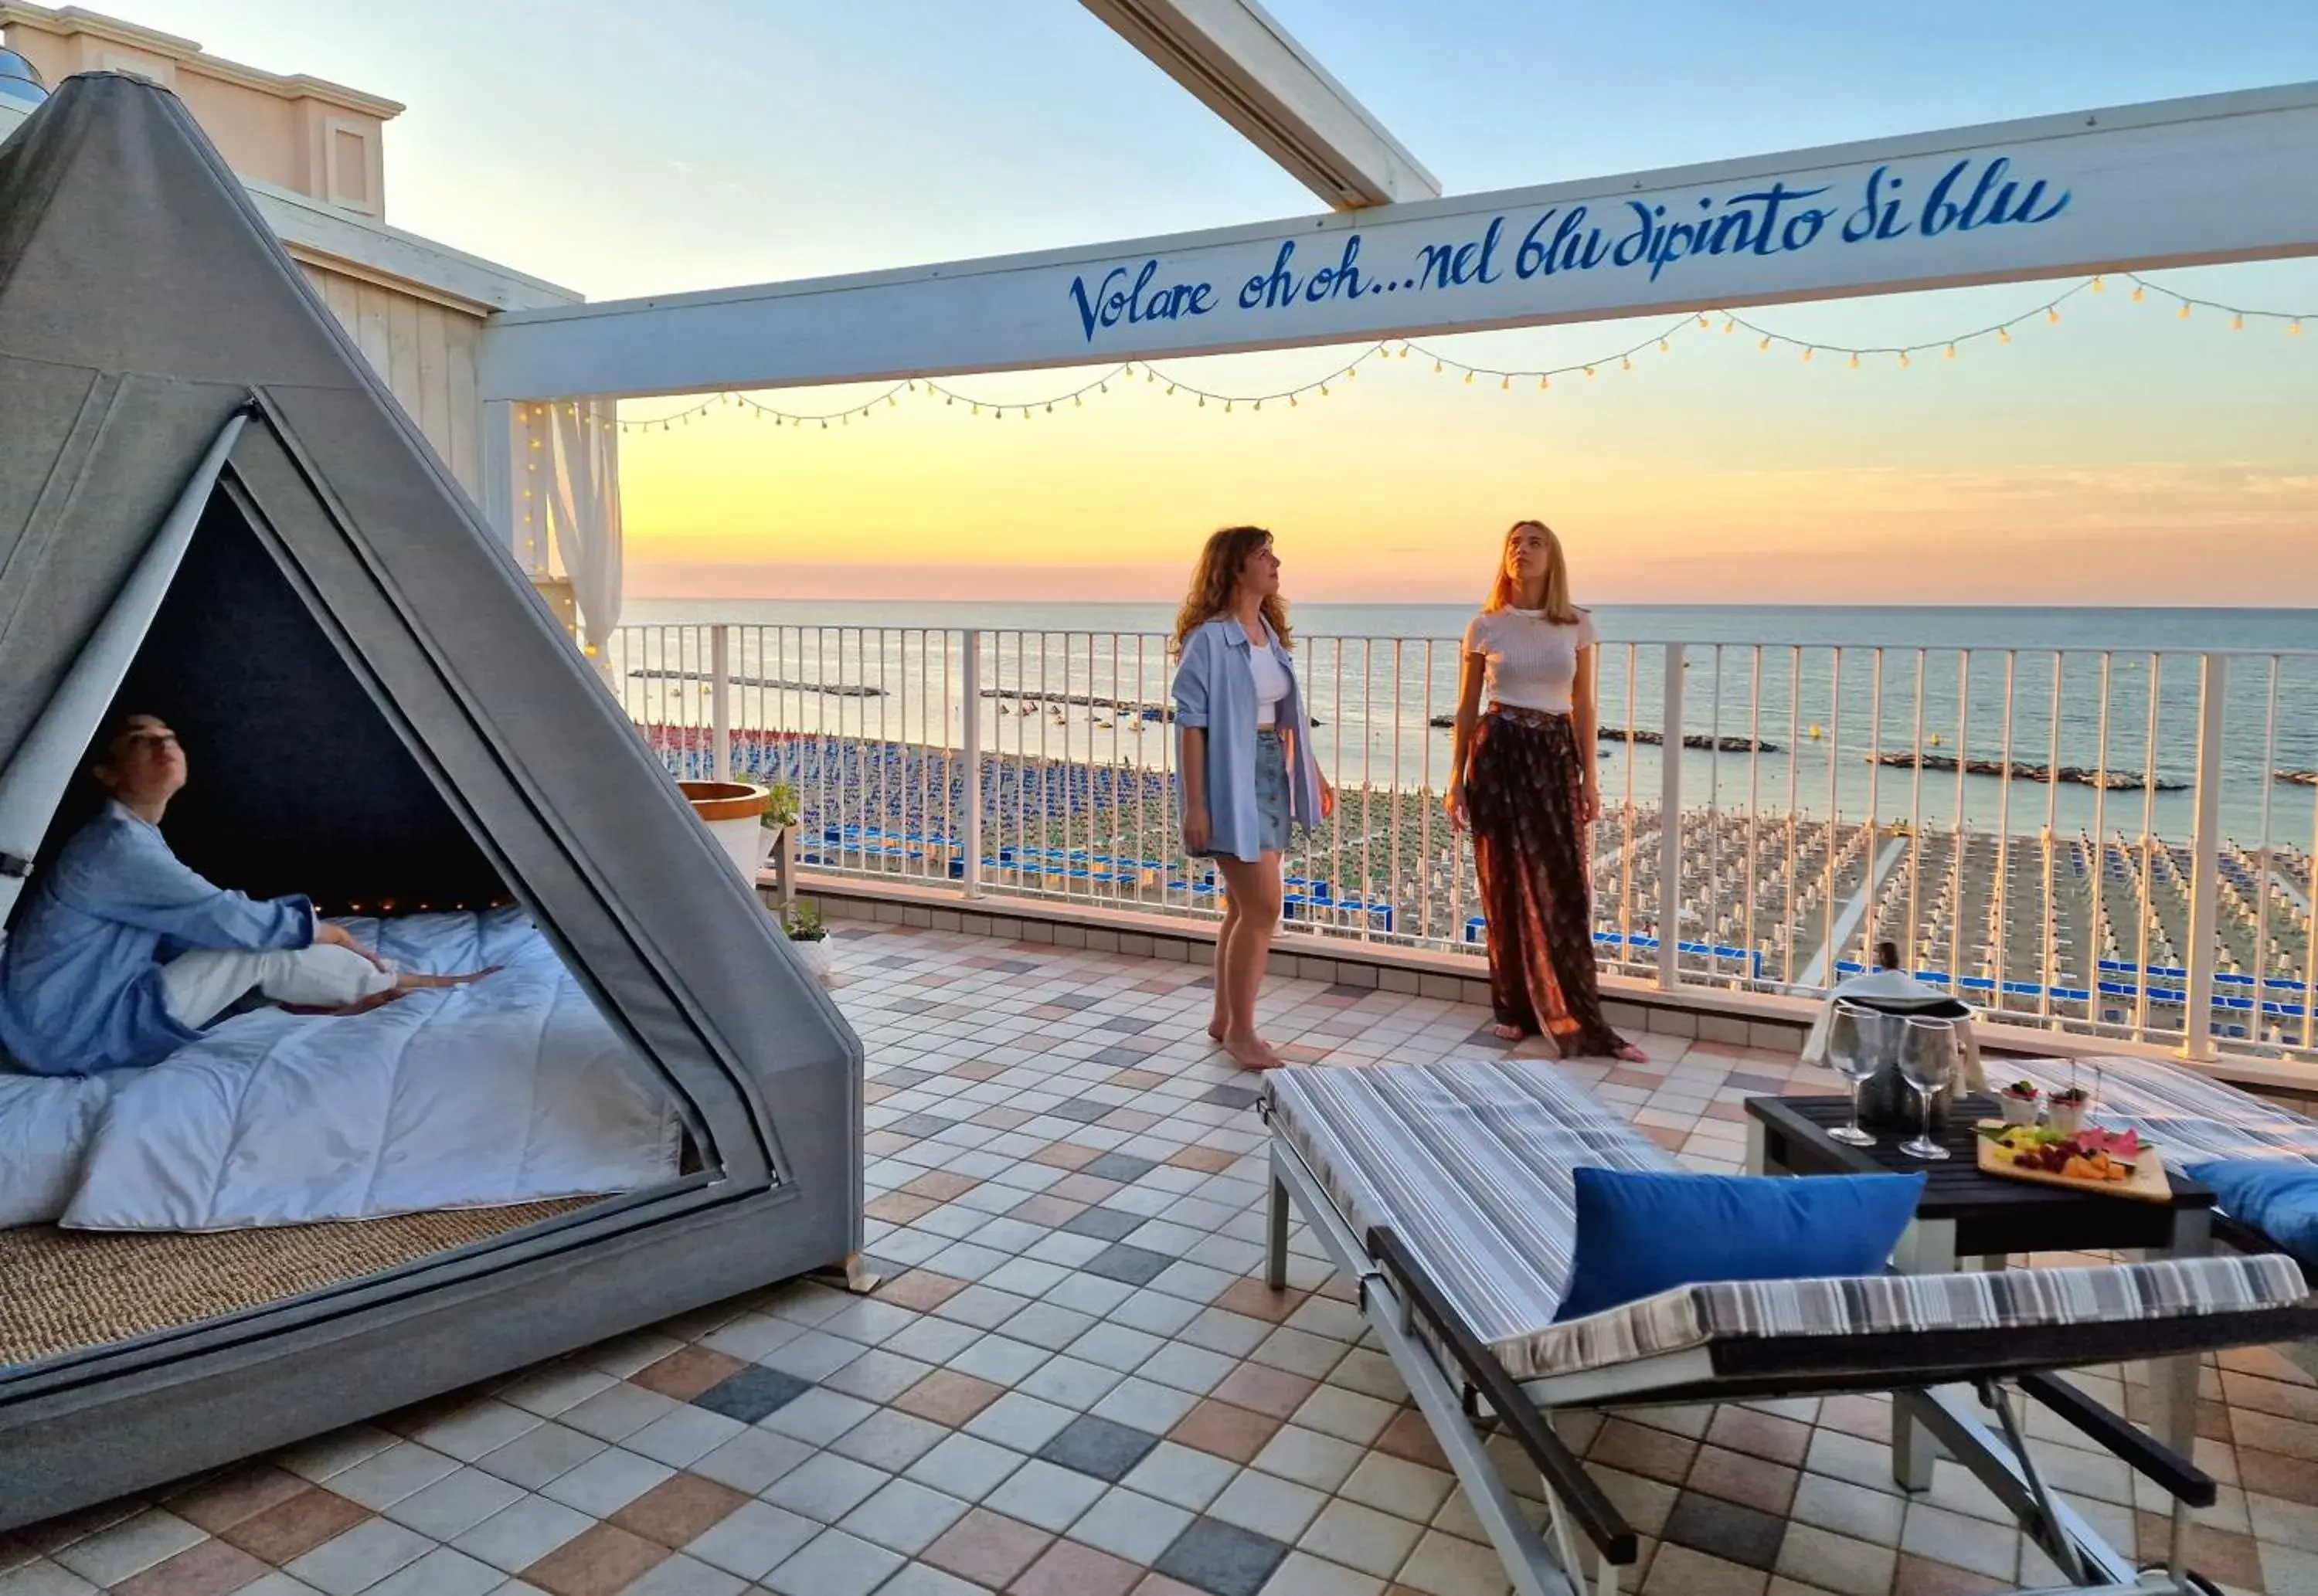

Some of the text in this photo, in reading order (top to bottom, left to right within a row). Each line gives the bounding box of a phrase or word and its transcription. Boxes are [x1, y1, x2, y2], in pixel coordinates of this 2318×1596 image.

[1069, 259, 1219, 345] Volare
[1238, 239, 1304, 309] oh
[1416, 216, 1507, 291] nel
[1515, 205, 1613, 280] blu
[1613, 182, 1840, 284] dipinto
[1841, 165, 1915, 243] di
[1919, 157, 2073, 238] blu
